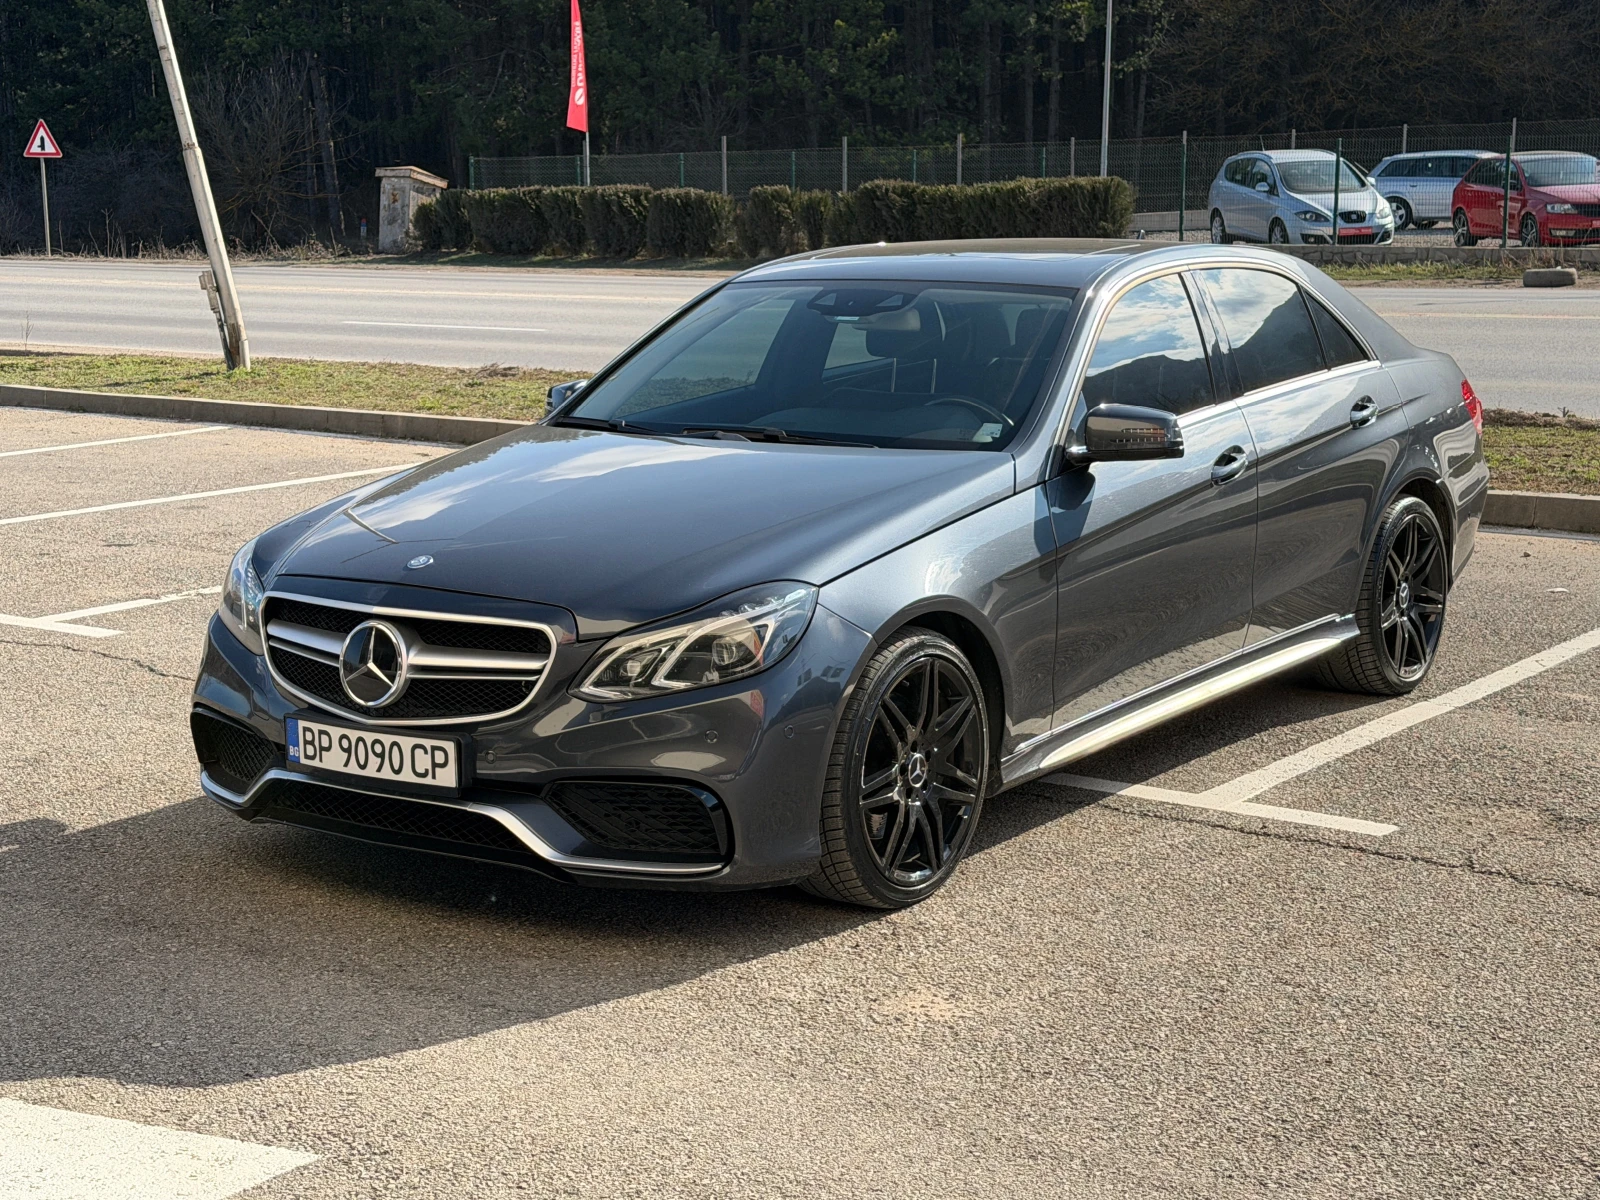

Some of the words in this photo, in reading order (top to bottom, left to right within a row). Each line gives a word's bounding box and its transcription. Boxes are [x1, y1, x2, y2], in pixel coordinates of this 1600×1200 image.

[289, 745, 299, 756] BG
[302, 726, 333, 763] BP
[338, 733, 404, 775] 9090
[410, 743, 449, 780] CP
